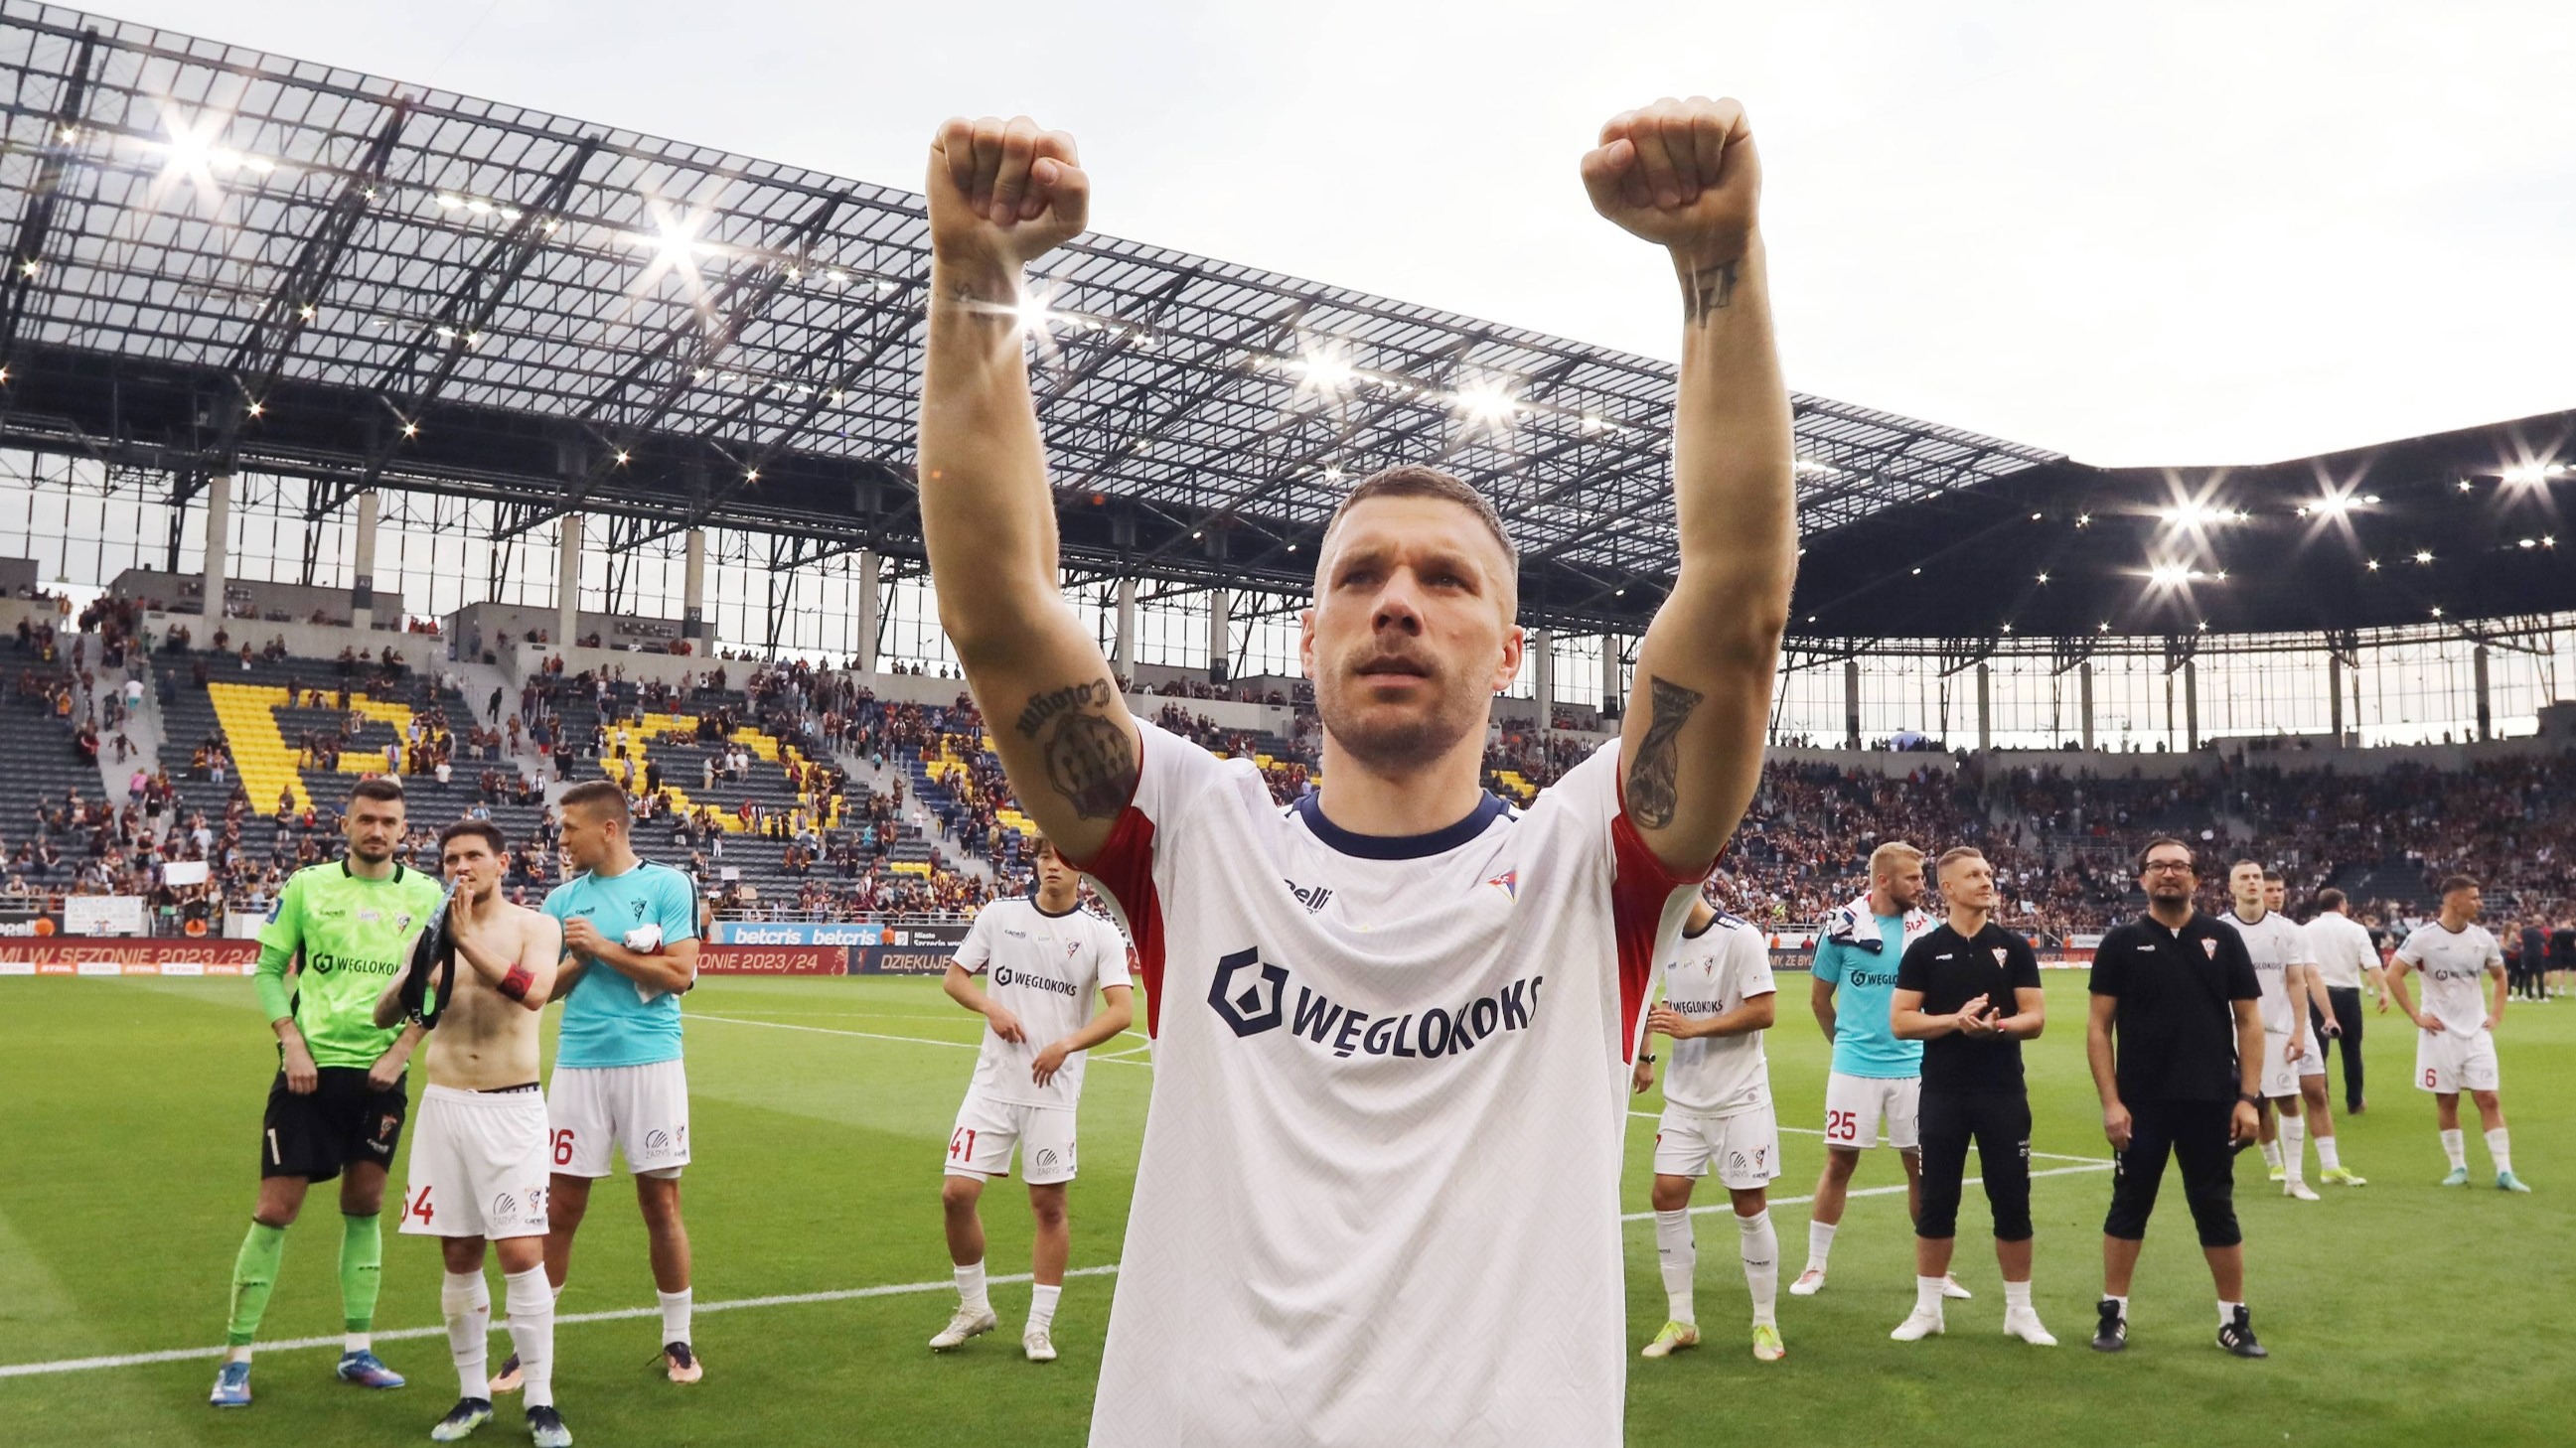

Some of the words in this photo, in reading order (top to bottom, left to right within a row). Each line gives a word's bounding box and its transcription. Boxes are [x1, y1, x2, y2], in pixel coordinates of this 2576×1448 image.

[1284, 878, 1333, 910] elli
[733, 928, 801, 944] betcris
[811, 930, 876, 945] betcris
[156, 947, 258, 964] 2023/24
[696, 953, 738, 969] ONIE
[740, 953, 818, 973] 2023/24
[1014, 971, 1078, 996] WĘGLOKOKS
[1291, 975, 1544, 1060] WĘGLOKOKS
[1673, 999, 1724, 1015] WĘGLOKOKS
[2425, 1068, 2437, 1088] 6
[1827, 1110, 1857, 1141] 25
[267, 1127, 281, 1166] 1
[950, 1126, 977, 1163] 41
